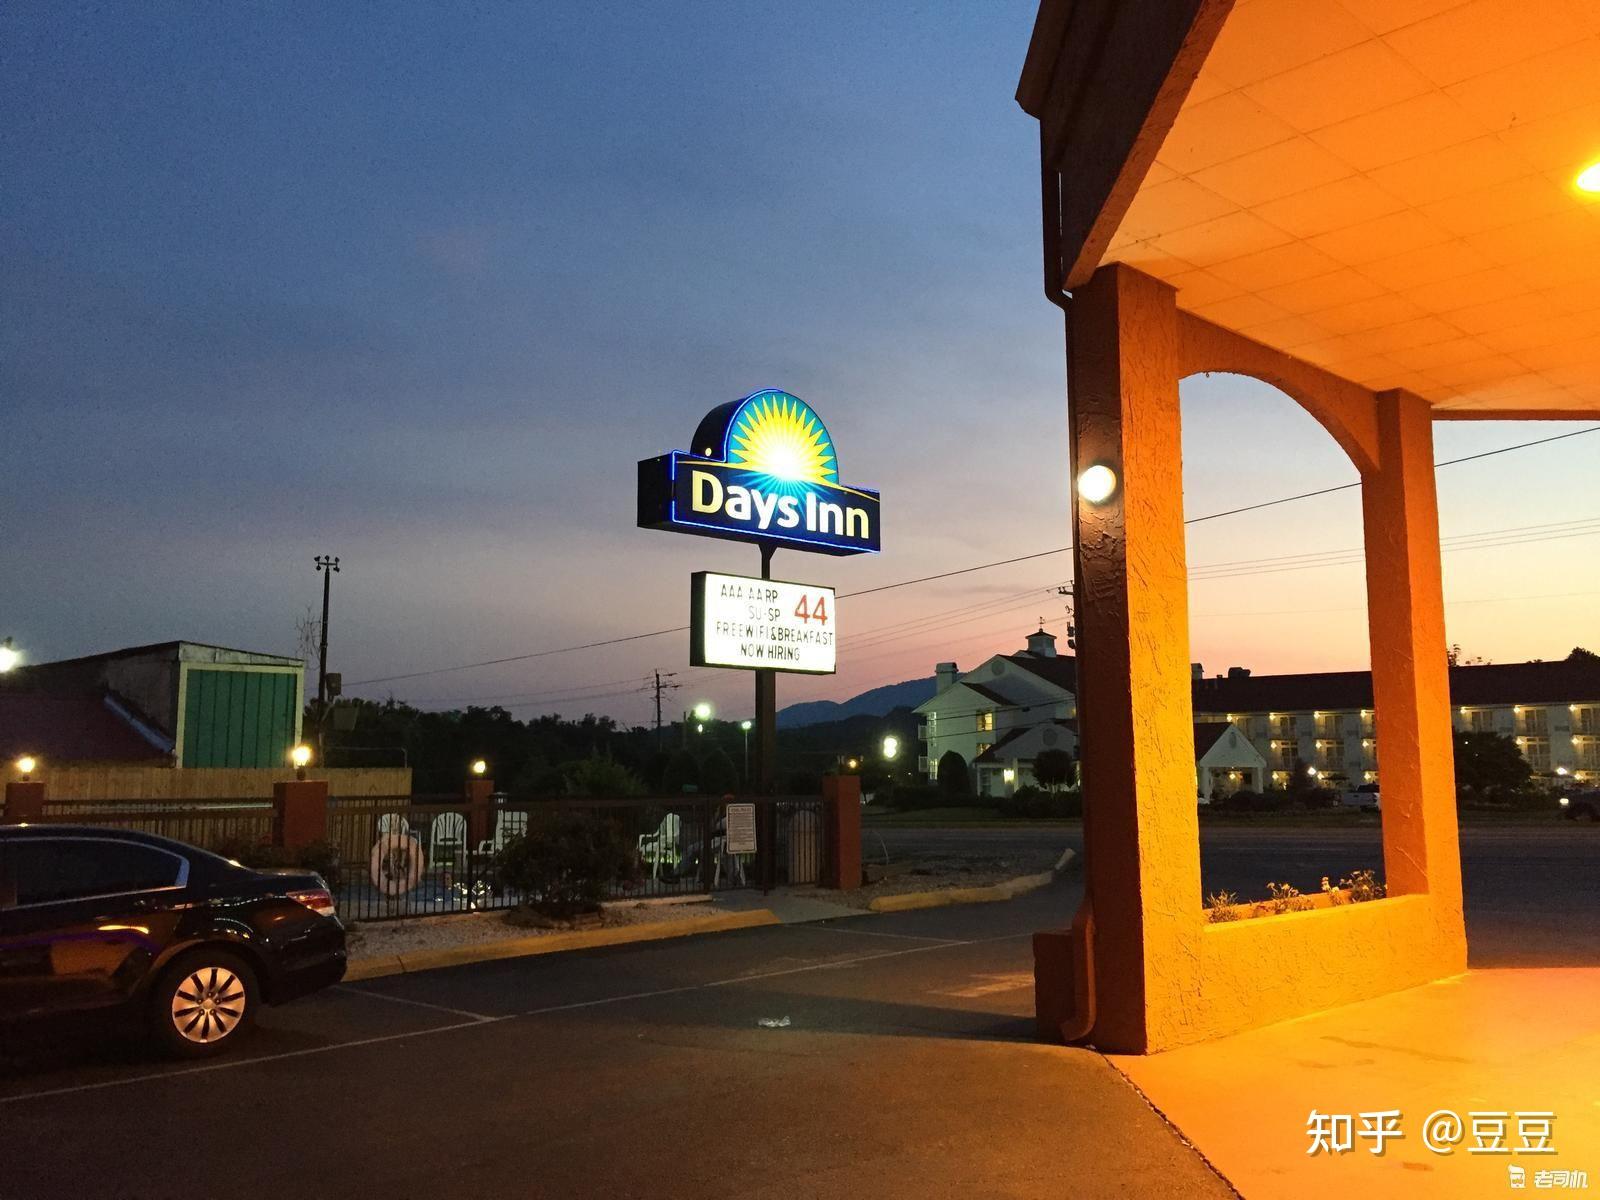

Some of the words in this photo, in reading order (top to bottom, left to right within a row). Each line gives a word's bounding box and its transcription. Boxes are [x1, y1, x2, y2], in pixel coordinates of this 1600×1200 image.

[691, 470, 799, 530] Days
[806, 492, 869, 539] Inn
[720, 584, 743, 598] AAA
[748, 587, 778, 603] AARP
[794, 594, 828, 626] 44
[740, 644, 764, 657] NOW
[768, 646, 800, 660] HIRING
